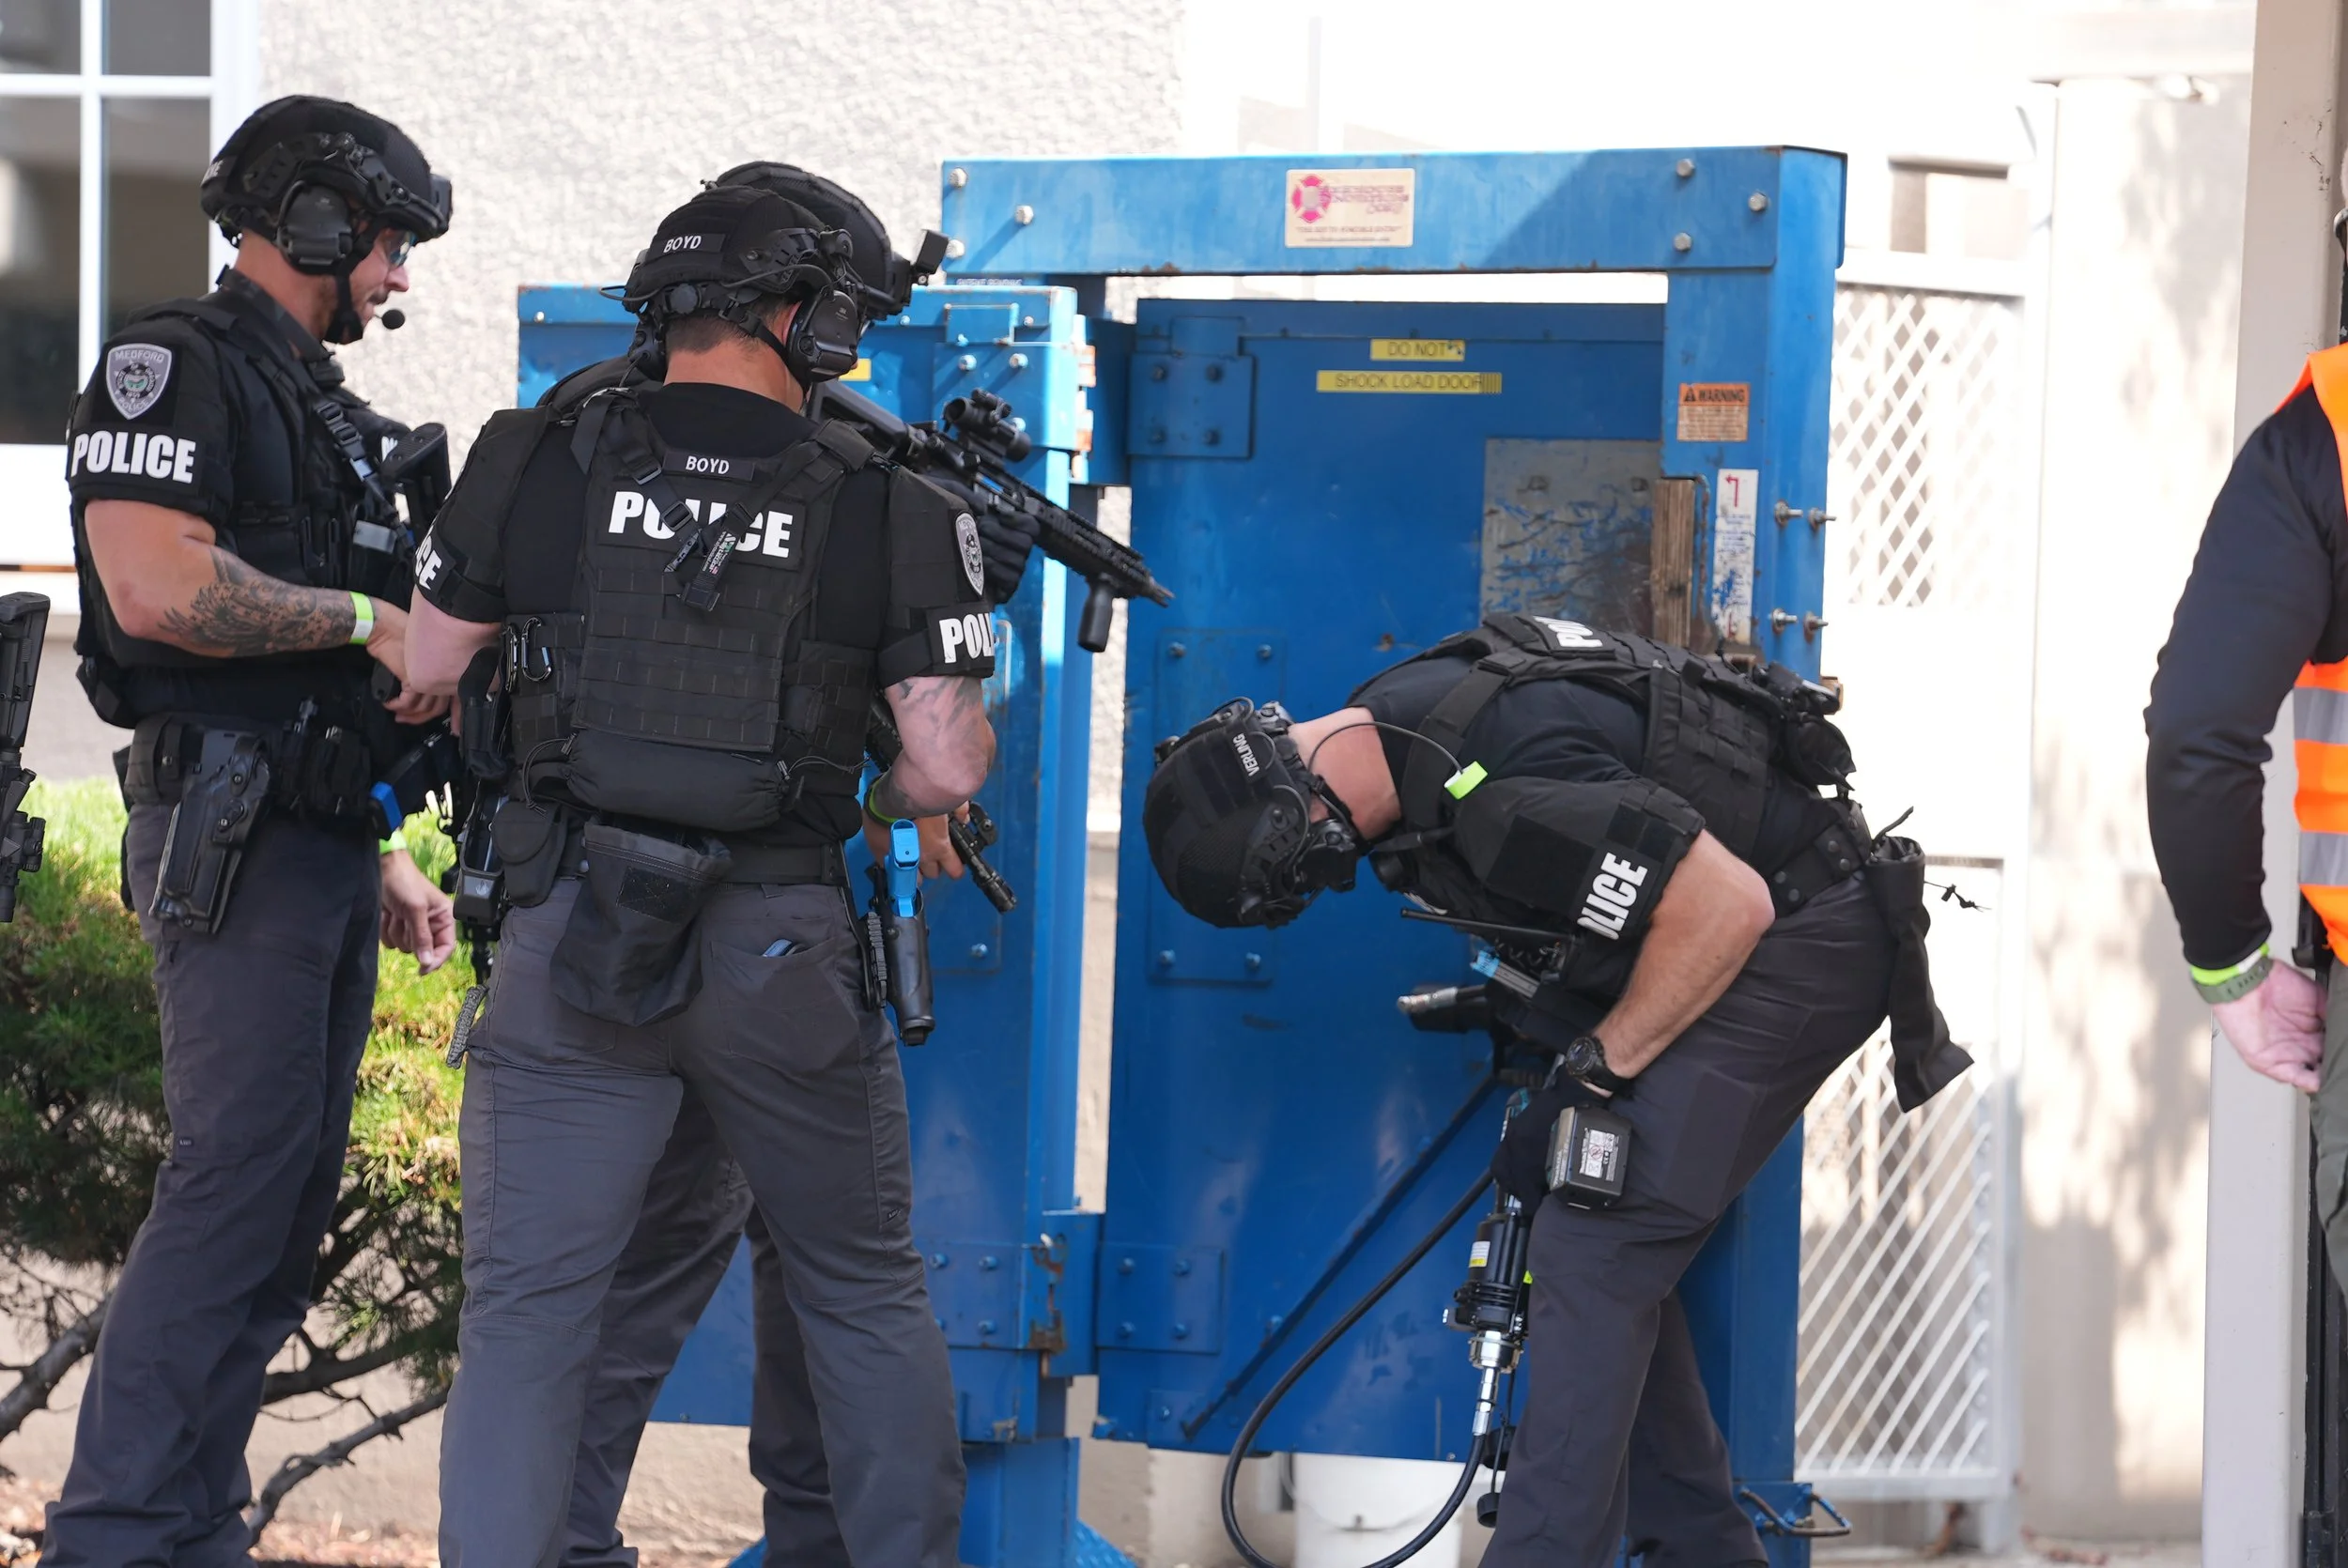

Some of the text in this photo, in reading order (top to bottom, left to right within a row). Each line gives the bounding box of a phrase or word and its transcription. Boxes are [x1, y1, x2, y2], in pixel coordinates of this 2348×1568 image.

[663, 235, 702, 254] BOYD
[115, 349, 165, 363] MEDFORD
[1387, 342, 1446, 356] DO NOT
[1336, 373, 1387, 389] SHOCK
[1393, 373, 1433, 390] LOAD
[117, 396, 150, 411] POLICE
[1698, 388, 1745, 403] WARNING
[70, 430, 196, 484] POLICE
[686, 455, 730, 475] BOYD
[1232, 733, 1260, 776] VERLING
